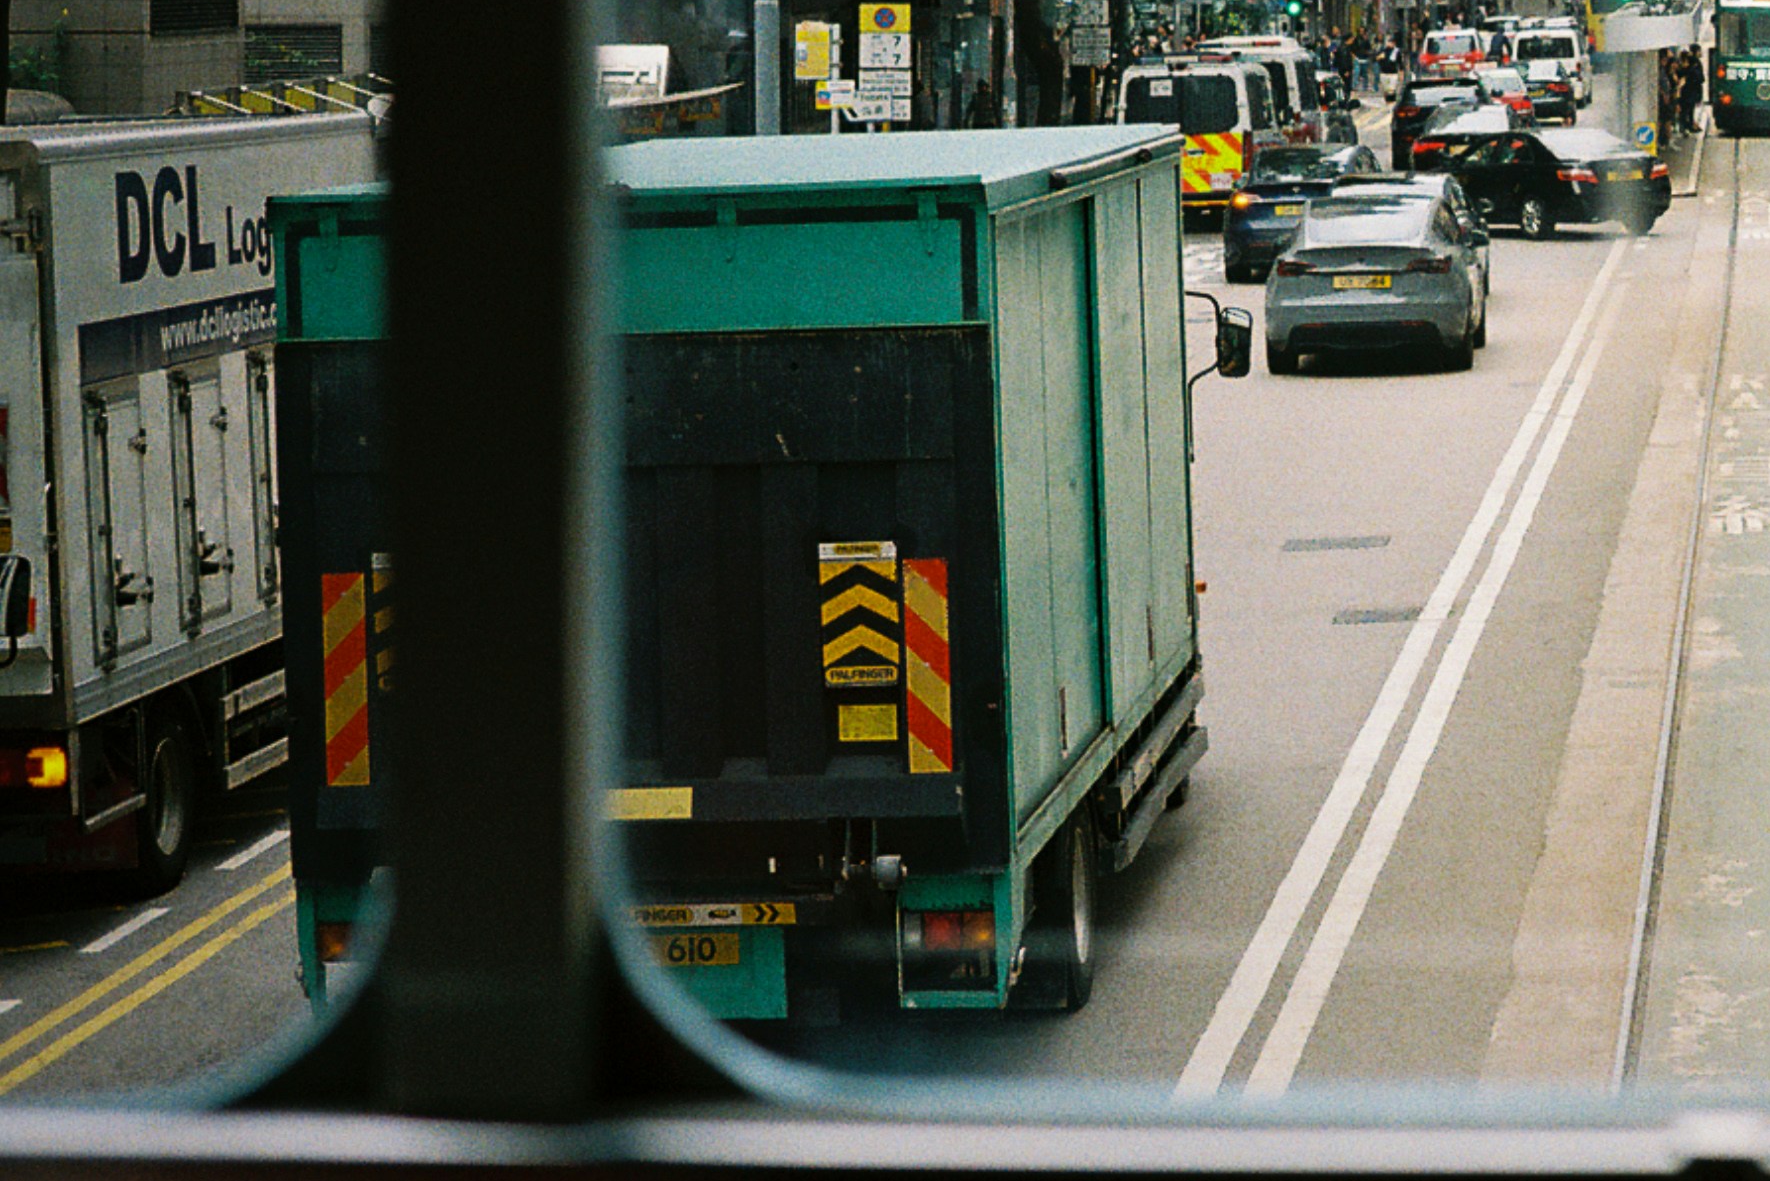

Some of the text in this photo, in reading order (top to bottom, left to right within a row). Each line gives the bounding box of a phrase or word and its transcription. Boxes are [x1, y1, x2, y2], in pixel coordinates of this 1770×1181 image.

[115, 164, 273, 284] DCL Log
[160, 298, 278, 351] www.dcllogistic.c
[830, 668, 894, 680] PALFINGER
[635, 908, 688, 922] FINGER
[667, 937, 717, 963] 610
